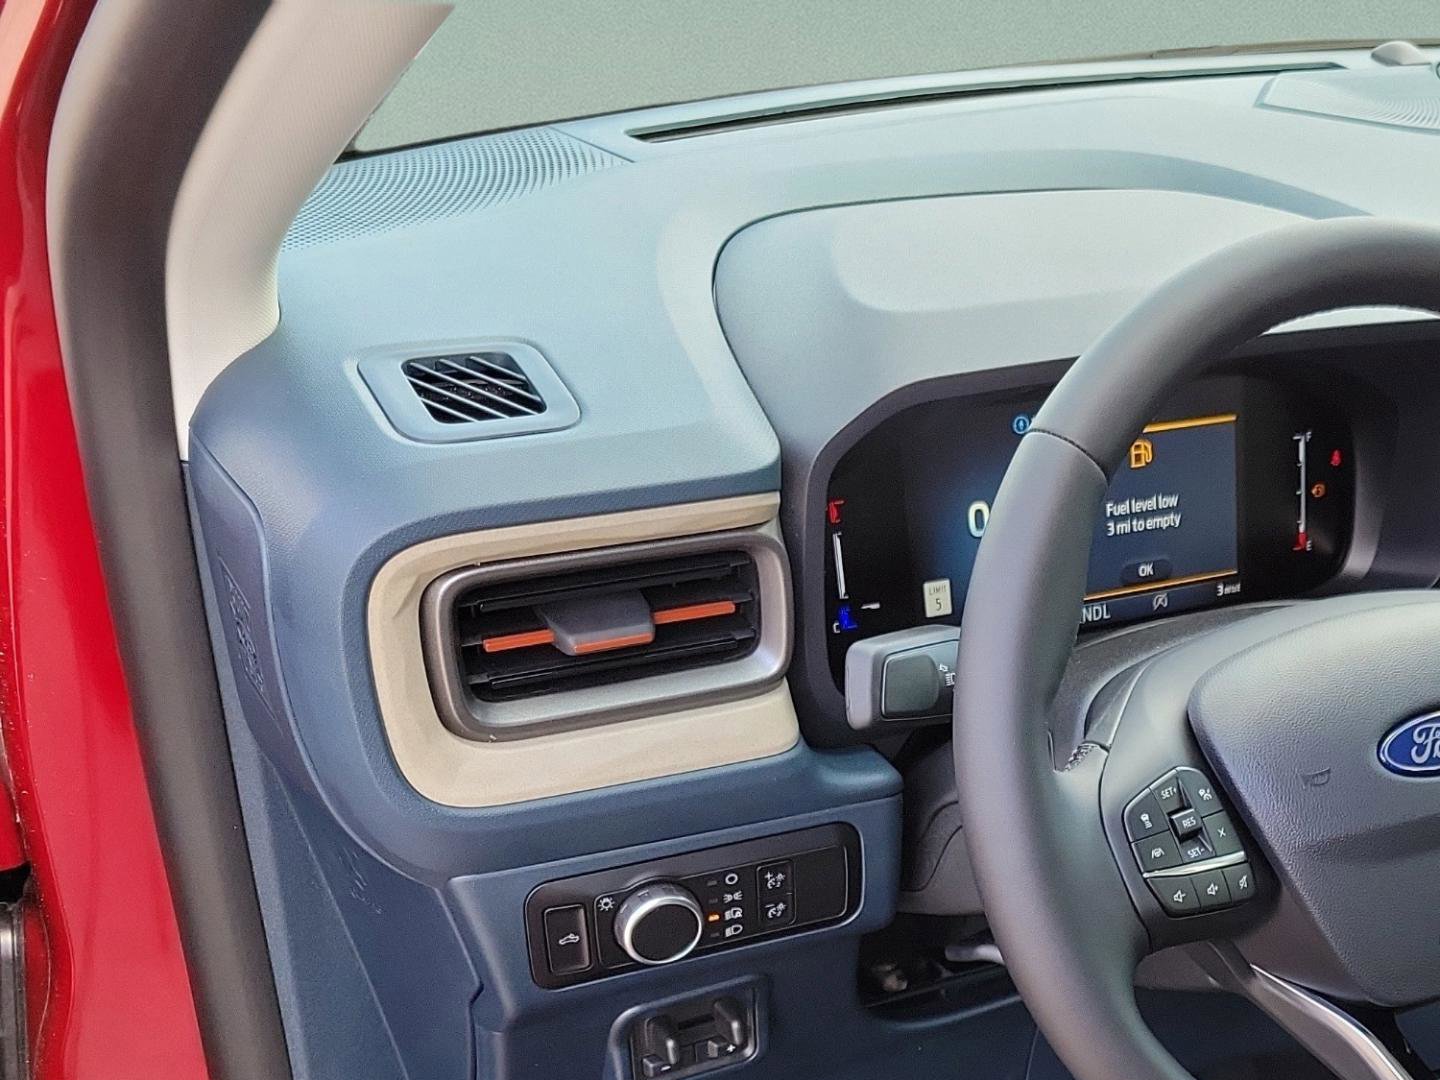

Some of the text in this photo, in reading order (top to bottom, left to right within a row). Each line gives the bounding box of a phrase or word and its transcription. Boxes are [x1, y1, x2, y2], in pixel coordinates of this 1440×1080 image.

[1106, 493, 1179, 517] Fuel level low
[1106, 513, 1182, 536] 3 mi to empty
[1138, 562, 1154, 577] OK
[1216, 583, 1224, 596] 3
[935, 598, 942, 612] 5
[1079, 603, 1111, 624] NDL
[1181, 816, 1196, 829] RES
